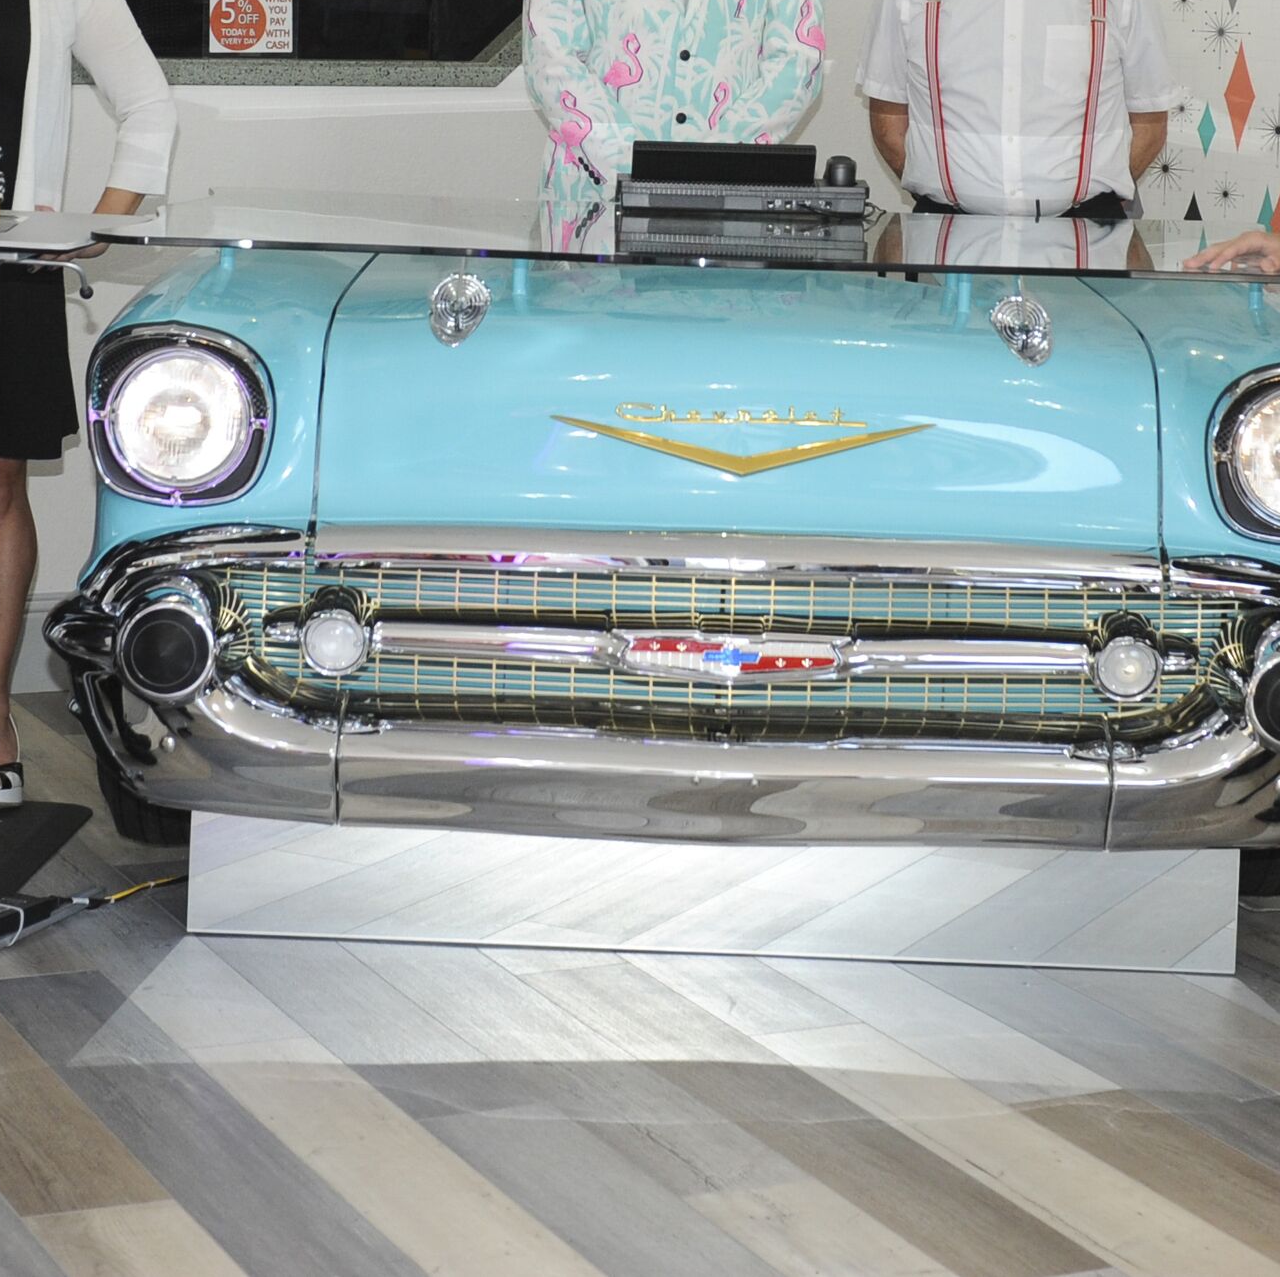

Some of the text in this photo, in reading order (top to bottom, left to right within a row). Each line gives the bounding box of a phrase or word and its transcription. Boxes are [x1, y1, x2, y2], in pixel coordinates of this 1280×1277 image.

[269, 6, 287, 14] YOU
[238, 14, 259, 24] OFF
[270, 17, 286, 26] PAY
[221, 28, 255, 36] TODAY &
[266, 28, 290, 38] WITH
[221, 37, 257, 45] EVERY DAY
[265, 41, 289, 49] CASH
